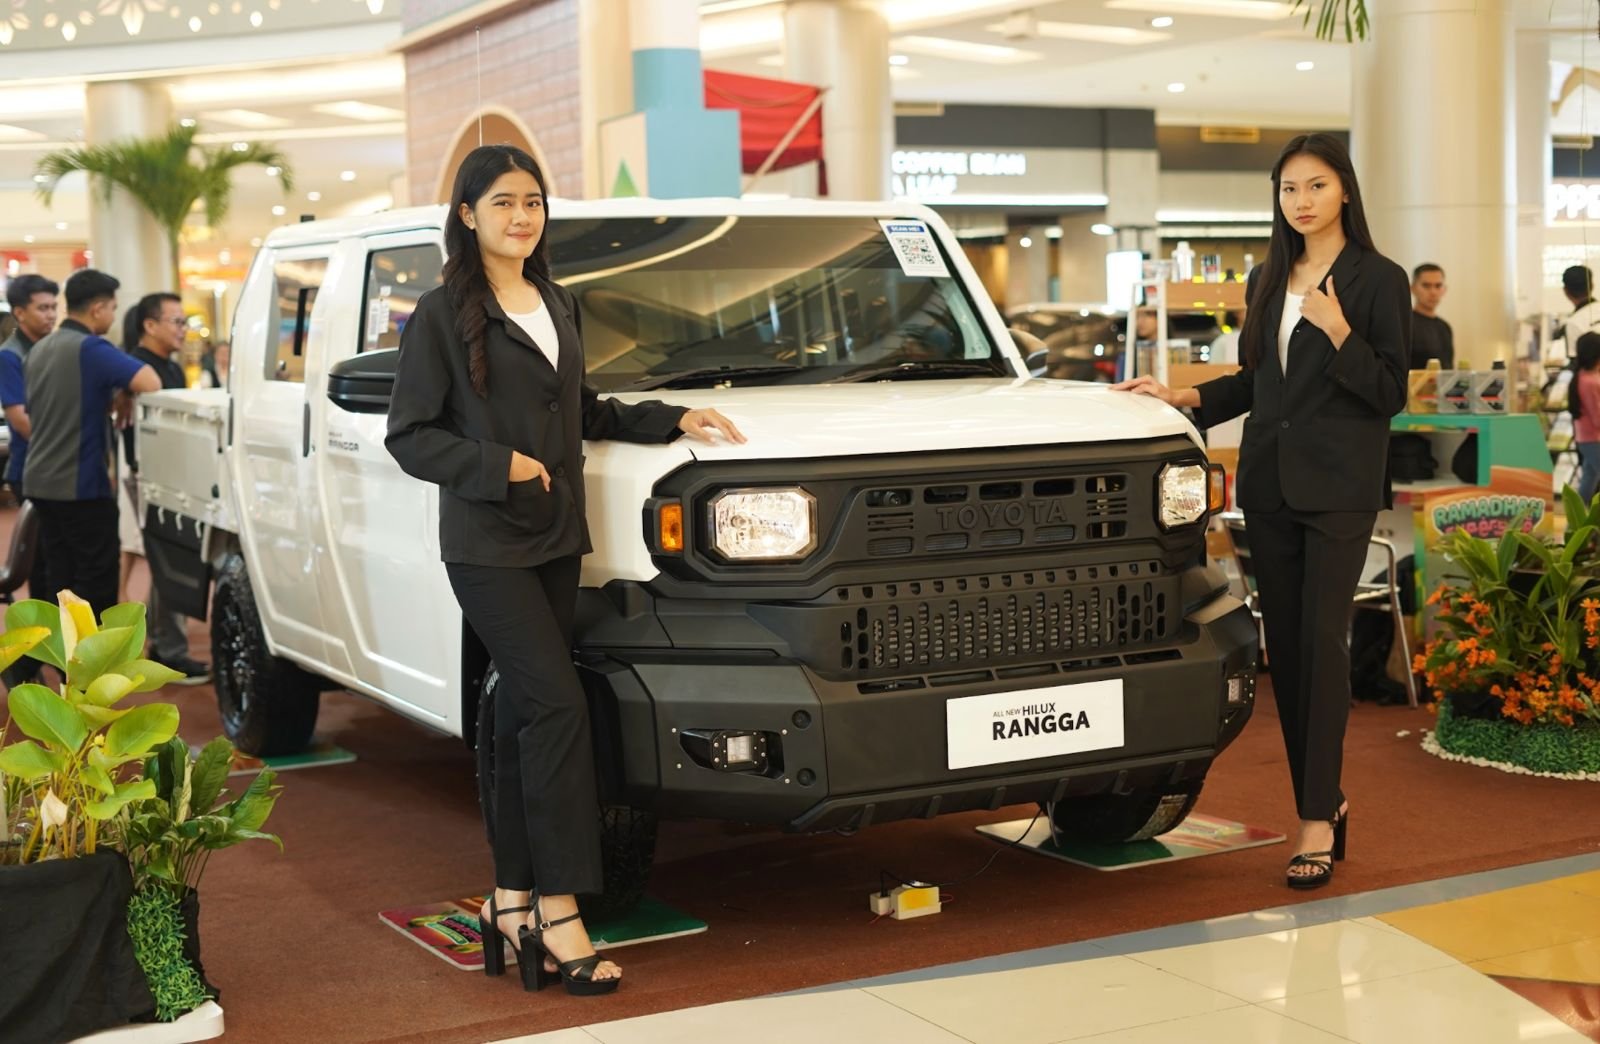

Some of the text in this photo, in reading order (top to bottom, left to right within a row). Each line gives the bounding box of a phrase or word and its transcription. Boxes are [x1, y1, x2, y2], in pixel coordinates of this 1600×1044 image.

[936, 500, 1067, 531] TOYOTA
[1434, 497, 1544, 527] RAMADHAN
[1005, 708, 1021, 717] NEW
[1022, 702, 1056, 717] HILUX
[992, 710, 1090, 741] RANGGA
